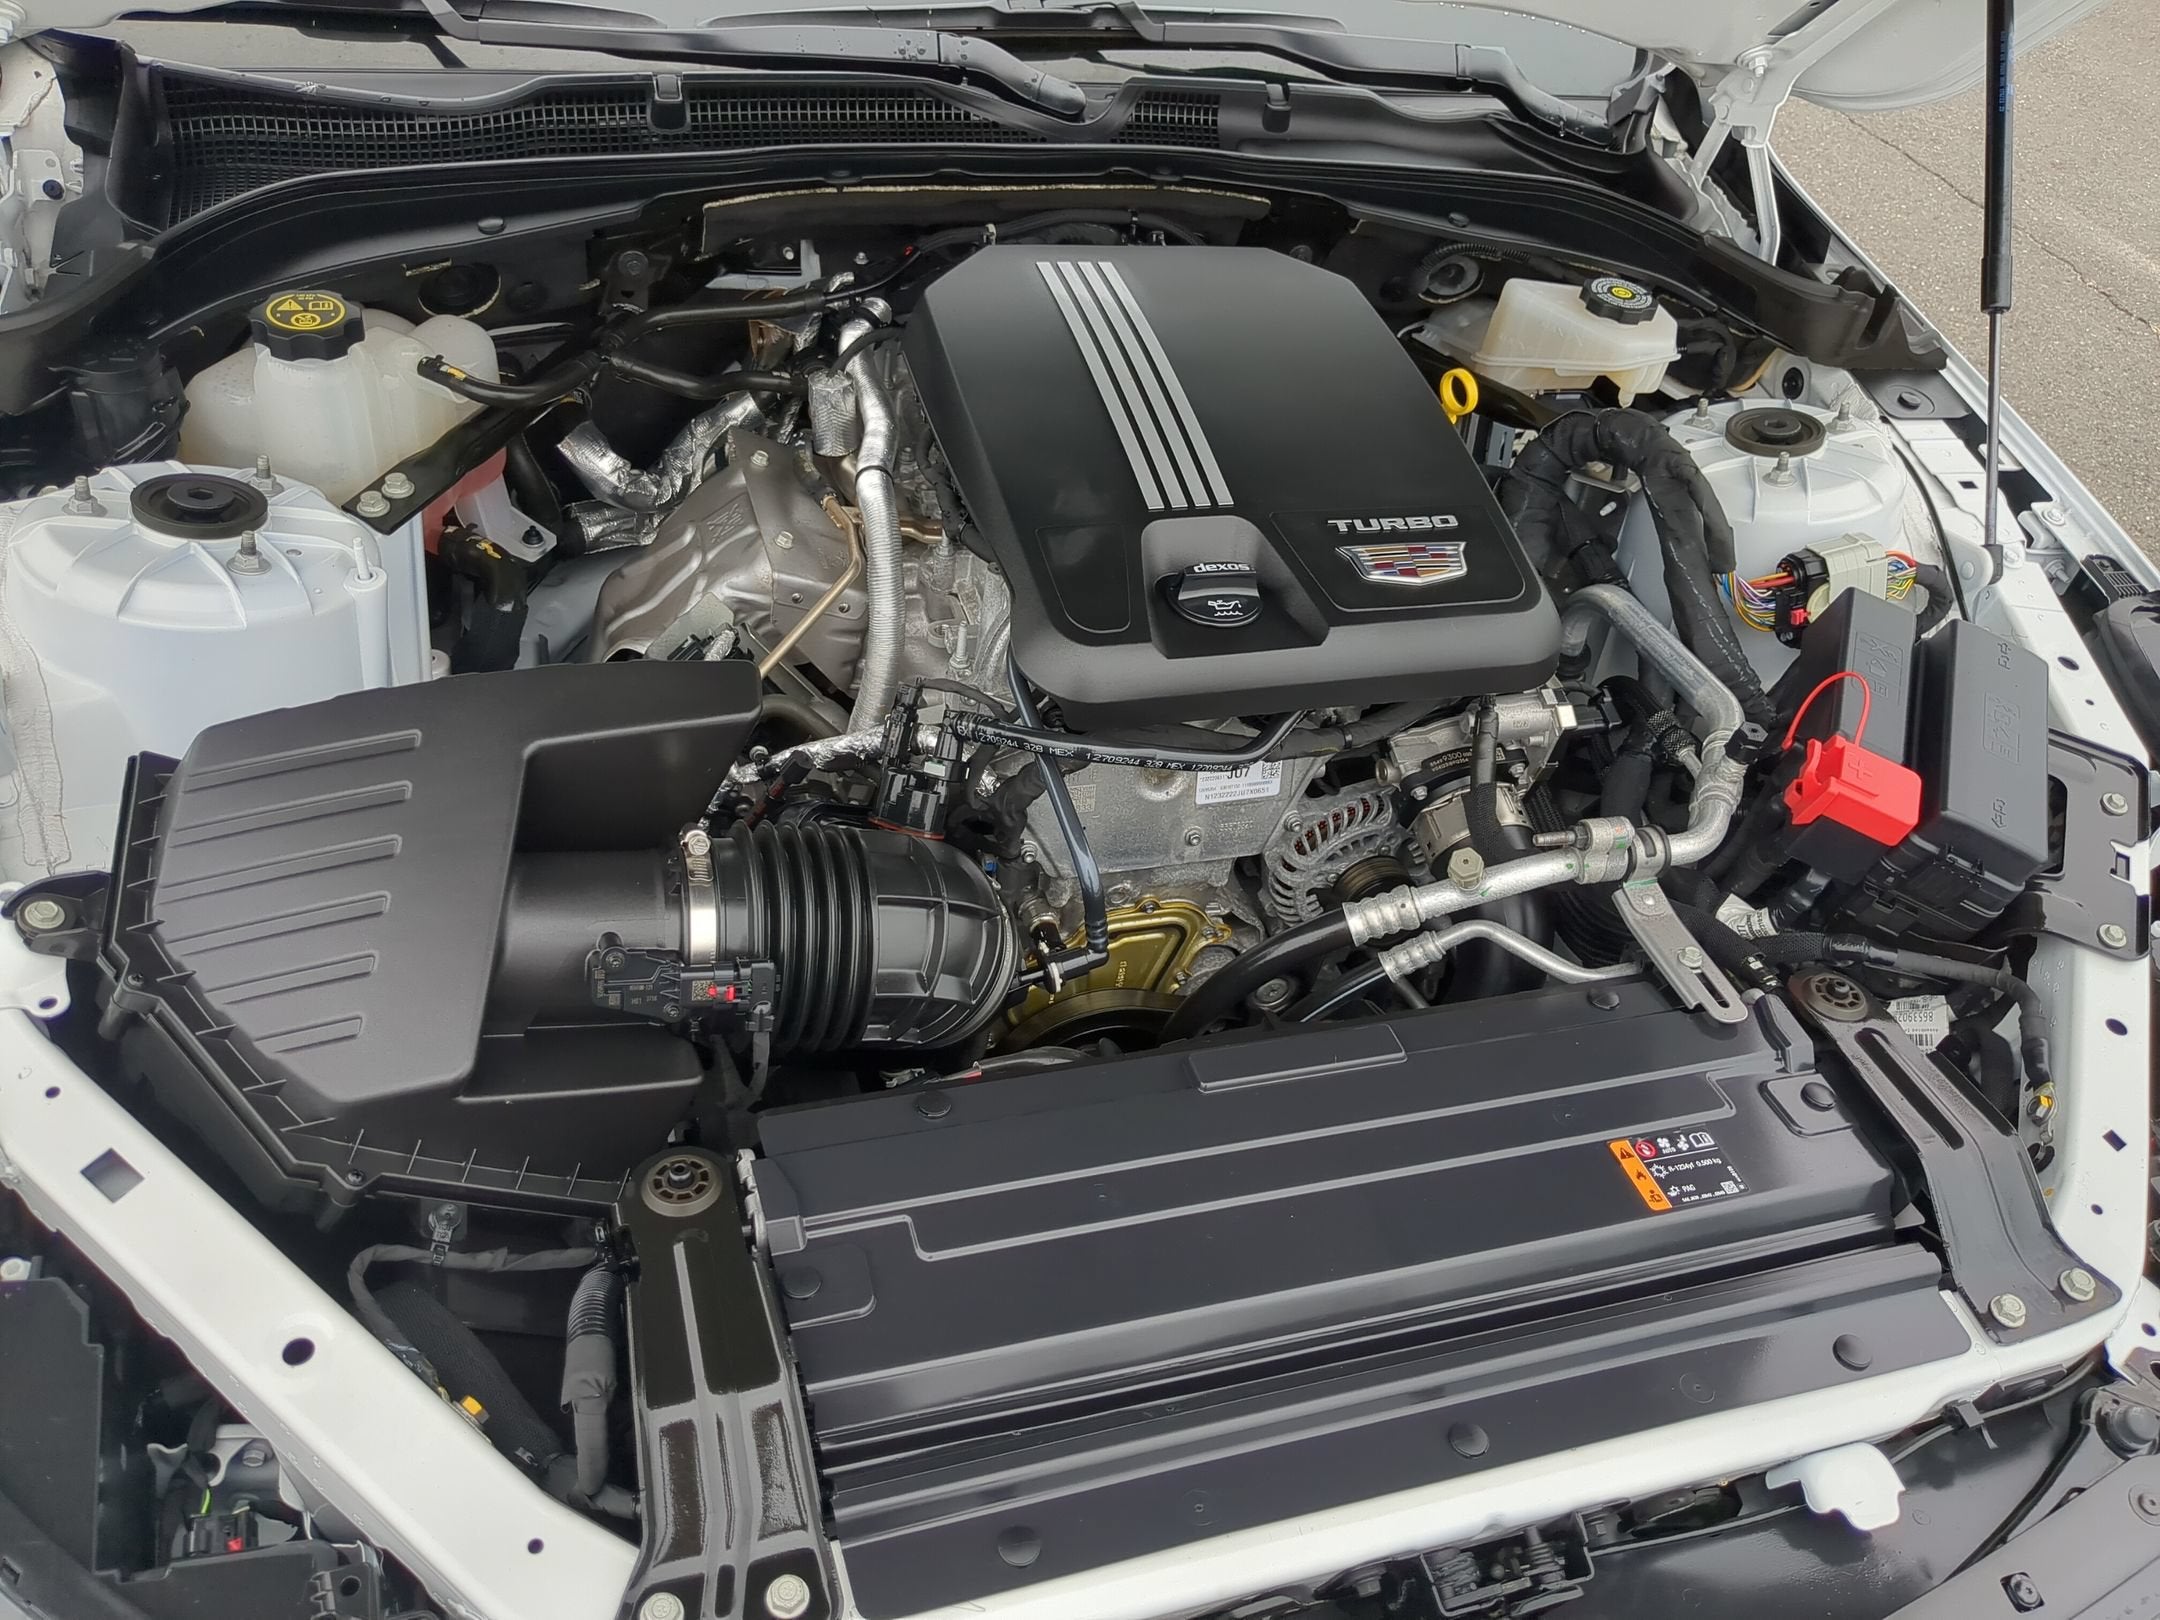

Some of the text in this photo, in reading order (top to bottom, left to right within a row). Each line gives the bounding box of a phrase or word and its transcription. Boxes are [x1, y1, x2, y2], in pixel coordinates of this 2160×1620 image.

[1327, 515, 1459, 532] TURBO
[1193, 563, 1250, 573] dexos
[1023, 742, 1044, 753] 328
[1049, 747, 1074, 757] MEX
[1086, 752, 1140, 766] 12709244
[1144, 759, 1163, 769] 328
[1165, 762, 1186, 770] MEX
[1711, 1157, 1722, 1165] kg
[1681, 1183, 1696, 1193] PAG
